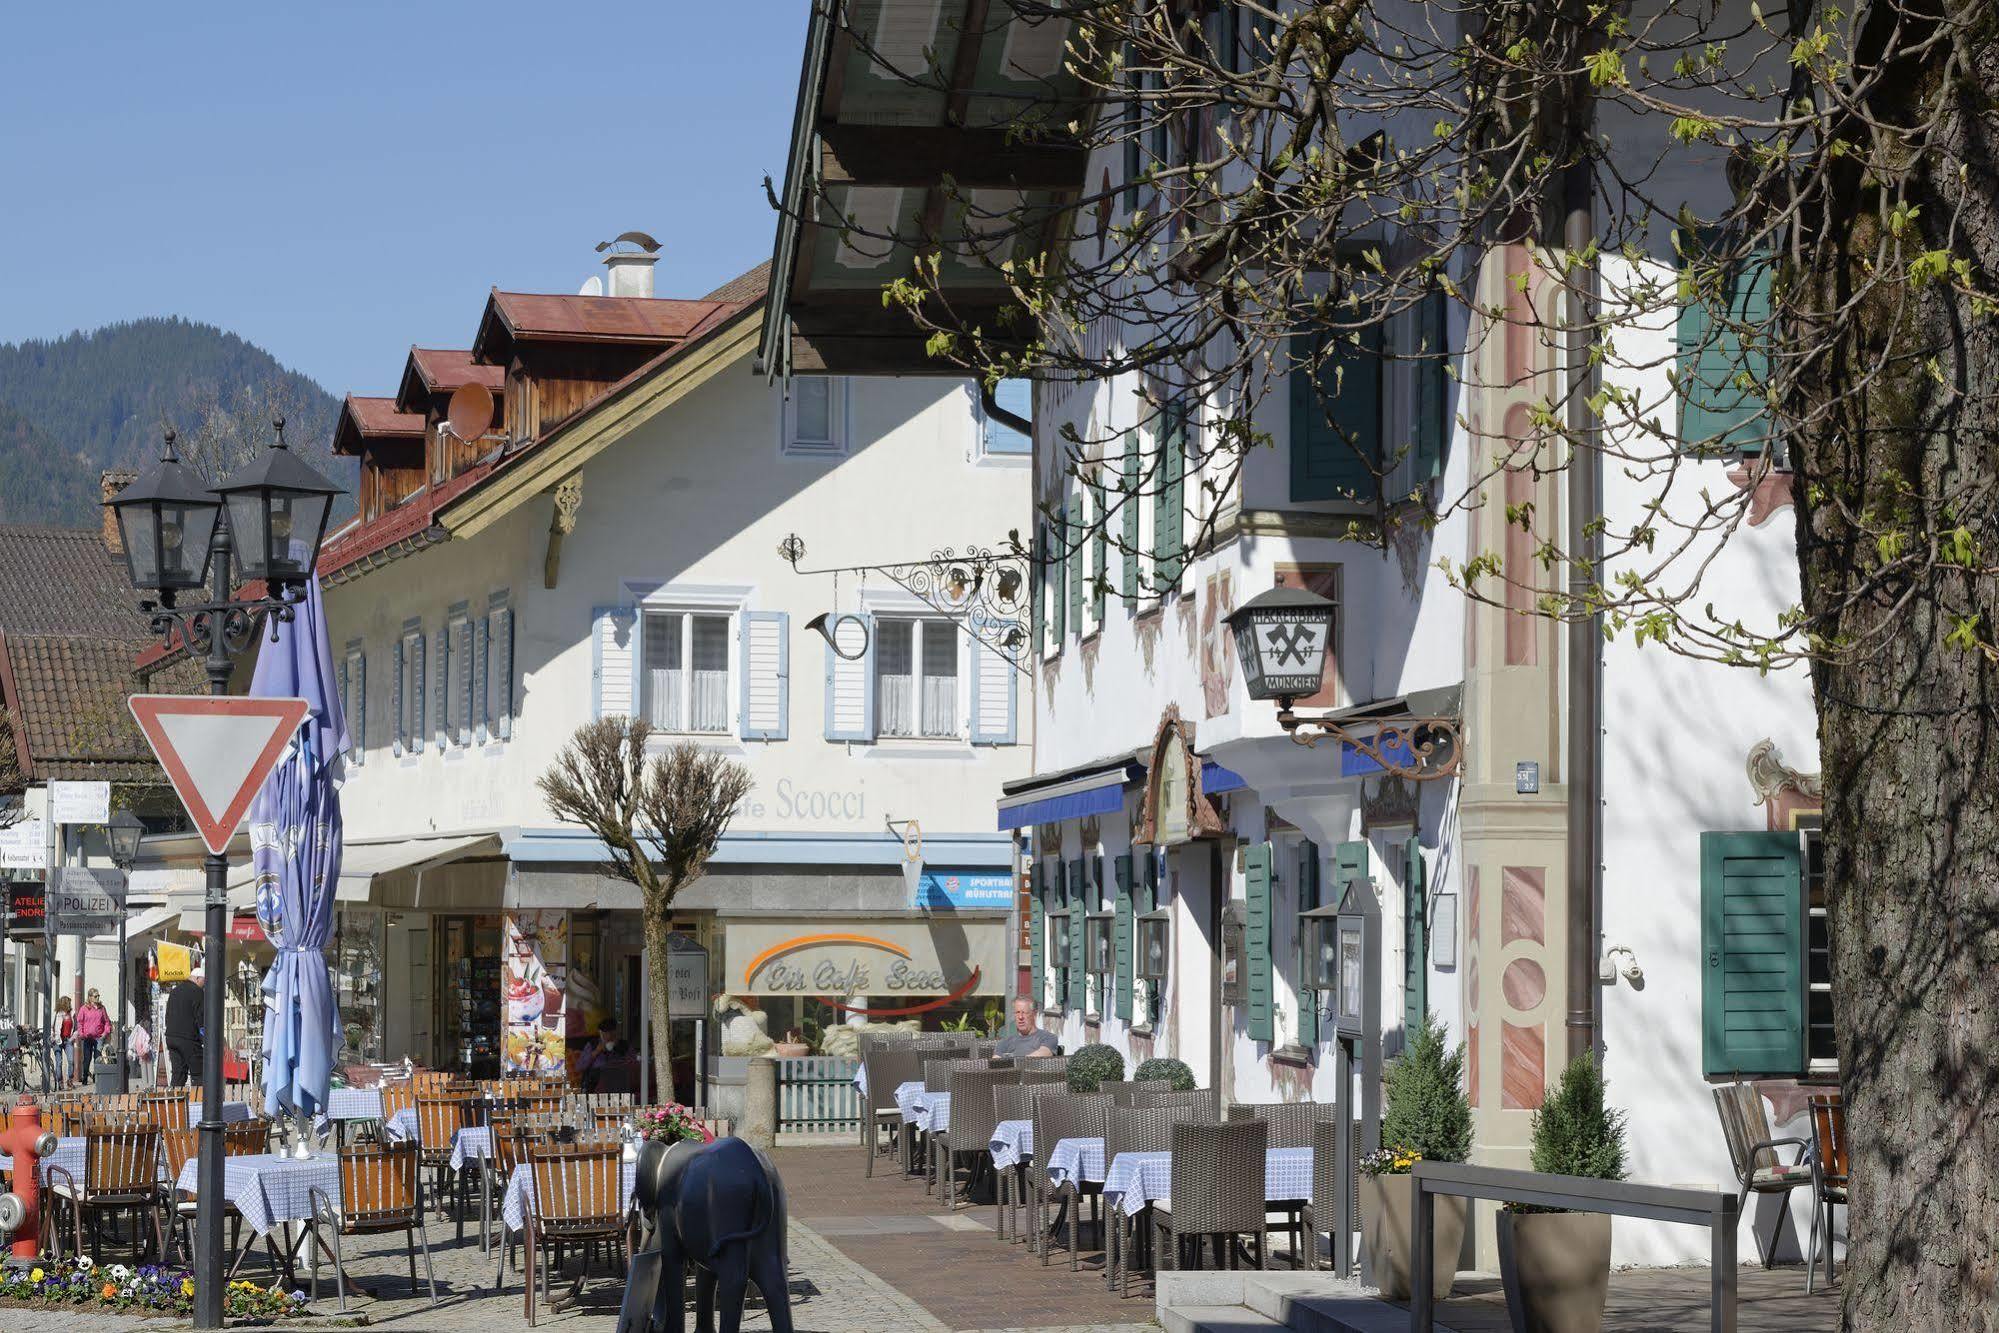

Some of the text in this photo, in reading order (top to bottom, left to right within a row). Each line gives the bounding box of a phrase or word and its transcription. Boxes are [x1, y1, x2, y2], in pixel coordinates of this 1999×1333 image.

[1264, 676, 1320, 689] MÜNCHEN
[776, 778, 865, 819] Scocci
[14, 896, 45, 906] ATELIE
[64, 897, 109, 911] POLIZEI
[16, 908, 45, 917] ENDRE
[765, 958, 807, 992] Eis
[812, 958, 870, 996] Café
